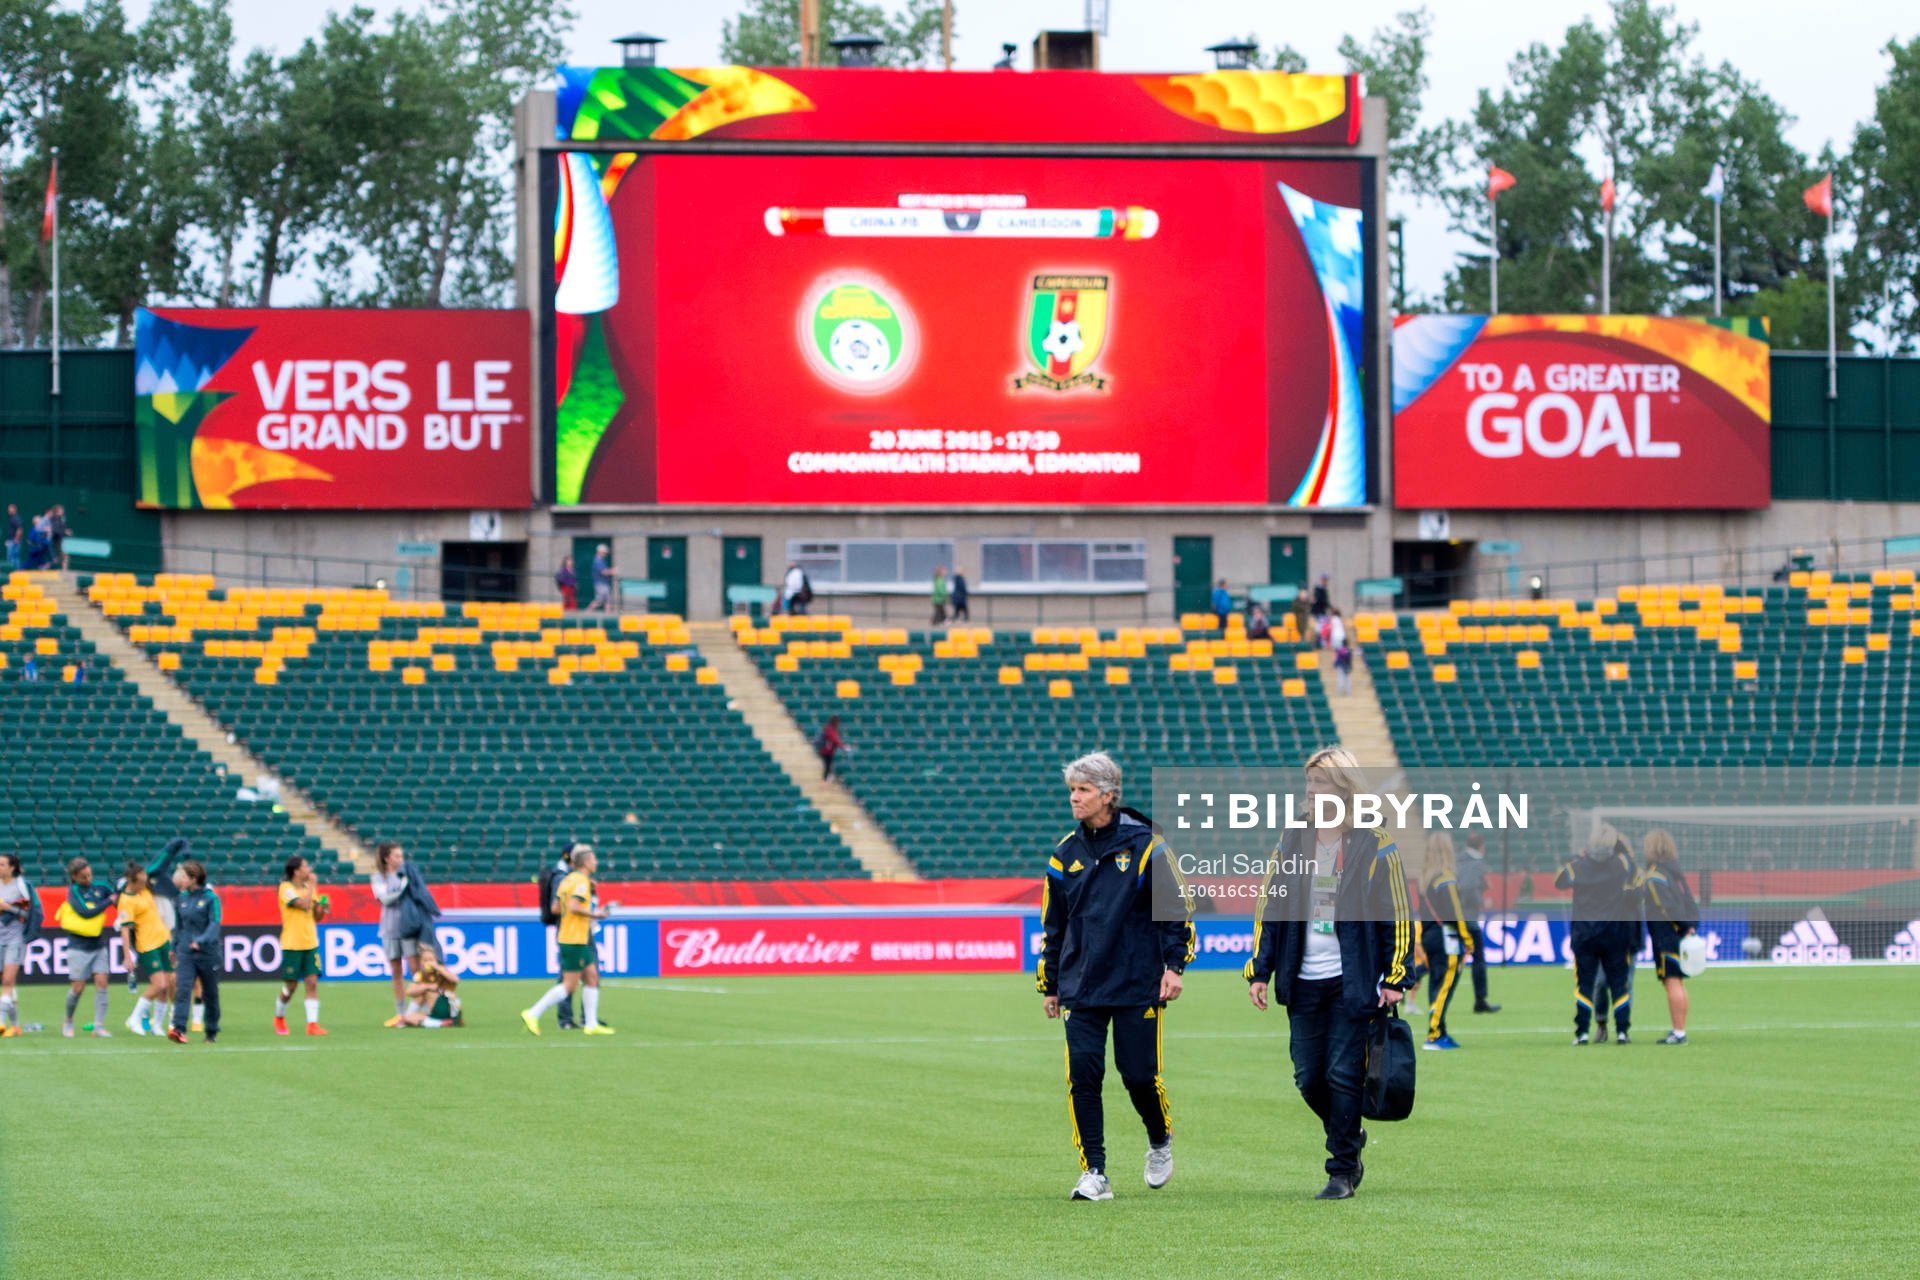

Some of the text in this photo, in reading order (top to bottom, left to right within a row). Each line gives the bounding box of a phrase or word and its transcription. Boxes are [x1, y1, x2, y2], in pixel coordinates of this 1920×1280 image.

[997, 215, 1083, 229] CAMEROON
[252, 359, 513, 412] VERS LE
[1458, 363, 1681, 393] TO A GREATER
[256, 413, 510, 451] GRAND BUT
[897, 430, 943, 450] JUNE
[1466, 393, 1681, 459] GOAL
[788, 453, 945, 473] COMMONWEALTH
[1035, 453, 1140, 473] EDMONTON
[666, 928, 860, 968] Budweiser
[870, 942, 934, 960] BREWED
[935, 942, 954, 959] IN
[955, 941, 1016, 960] CANADA
